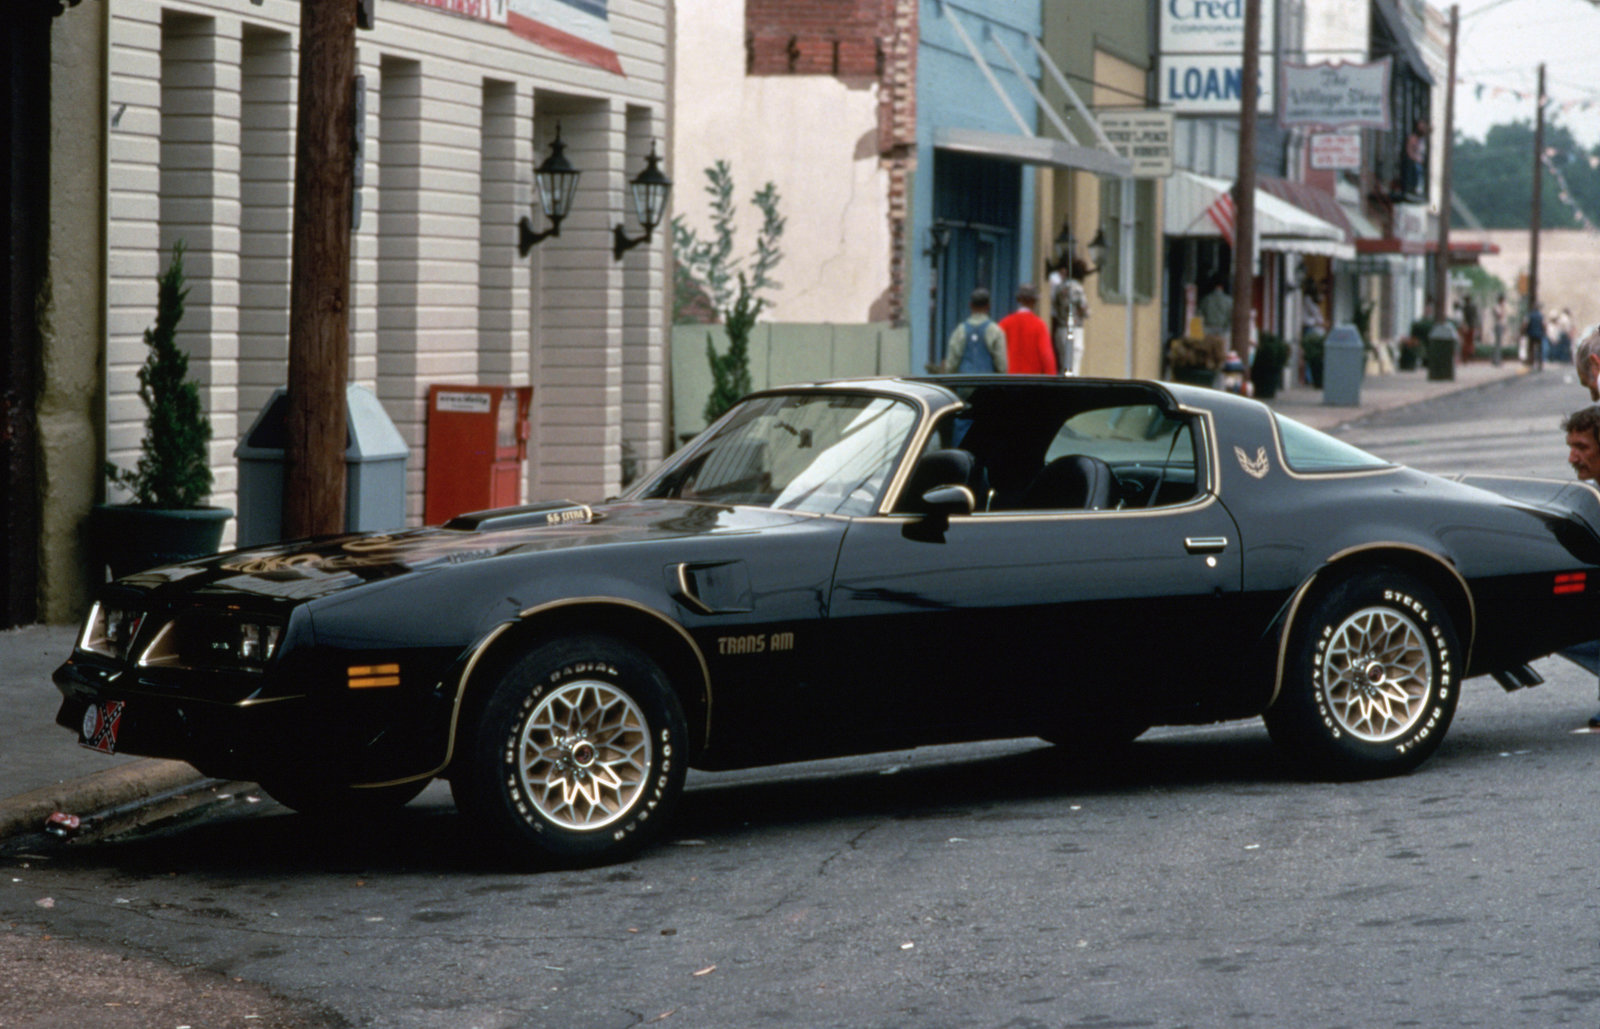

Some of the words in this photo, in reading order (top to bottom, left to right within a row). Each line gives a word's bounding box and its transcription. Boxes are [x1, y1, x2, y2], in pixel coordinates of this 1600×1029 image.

[1168, 0, 1243, 20] Cred
[1168, 67, 1262, 101] LOAN
[1384, 590, 1429, 622] STEEL
[718, 634, 766, 655] TRANS
[770, 632, 795, 652] AM
[551, 662, 619, 683] RADIAL
[1431, 625, 1450, 700] BELTED
[1395, 707, 1442, 753] RADIAL
